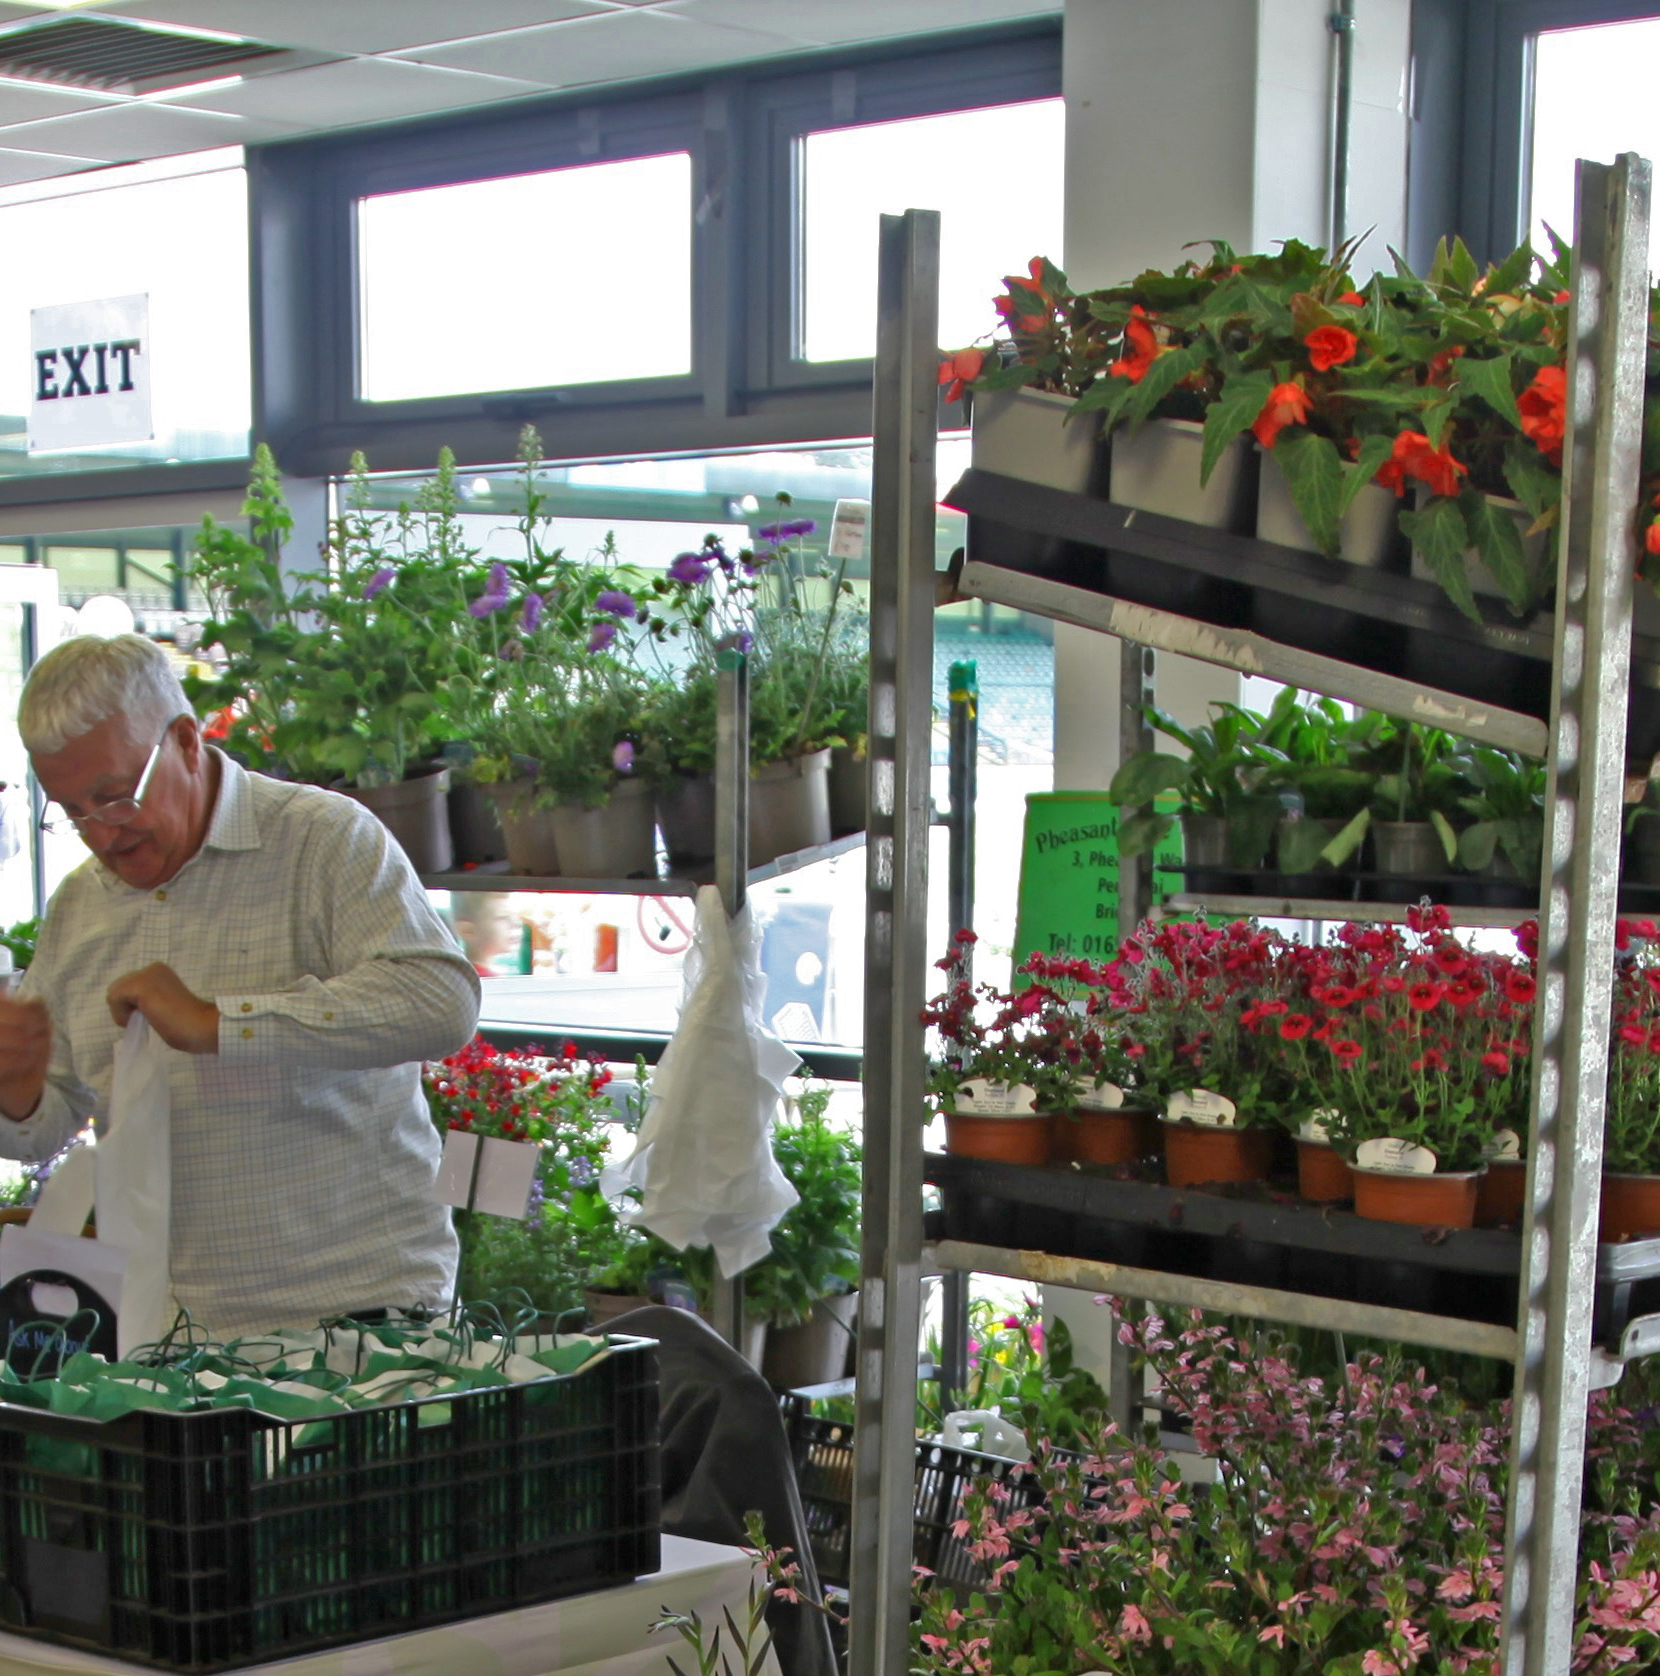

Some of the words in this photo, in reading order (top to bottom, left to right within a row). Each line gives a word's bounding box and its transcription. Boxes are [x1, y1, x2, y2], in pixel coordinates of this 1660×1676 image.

[36, 338, 141, 401] EXIT
[1035, 816, 1117, 854] Pheasant
[1049, 932, 1077, 952] Tel:
